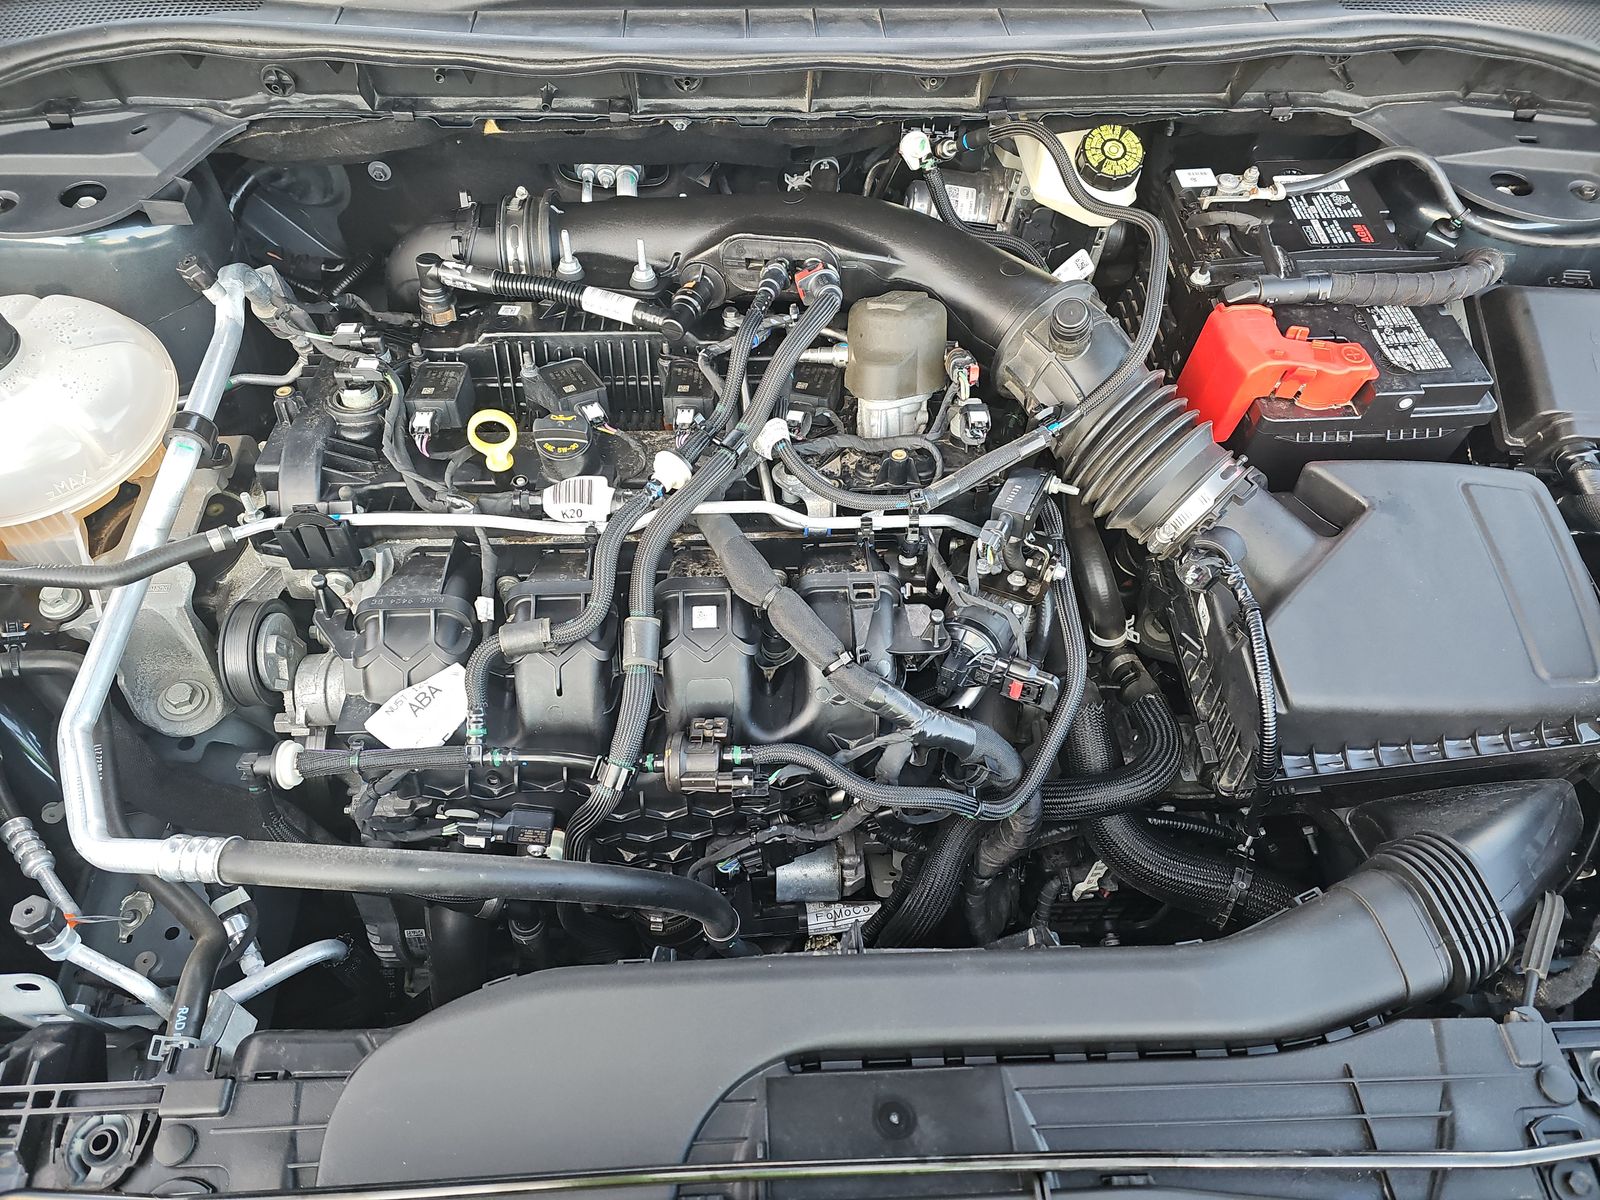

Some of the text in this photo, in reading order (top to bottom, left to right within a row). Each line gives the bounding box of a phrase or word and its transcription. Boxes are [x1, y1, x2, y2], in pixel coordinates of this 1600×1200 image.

[1352, 224, 1371, 242] AGM
[53, 469, 93, 495] MAX
[561, 508, 583, 519] K20
[408, 685, 442, 718] ABA
[815, 906, 870, 921] FoMoCo
[174, 1006, 190, 1031] RAD
